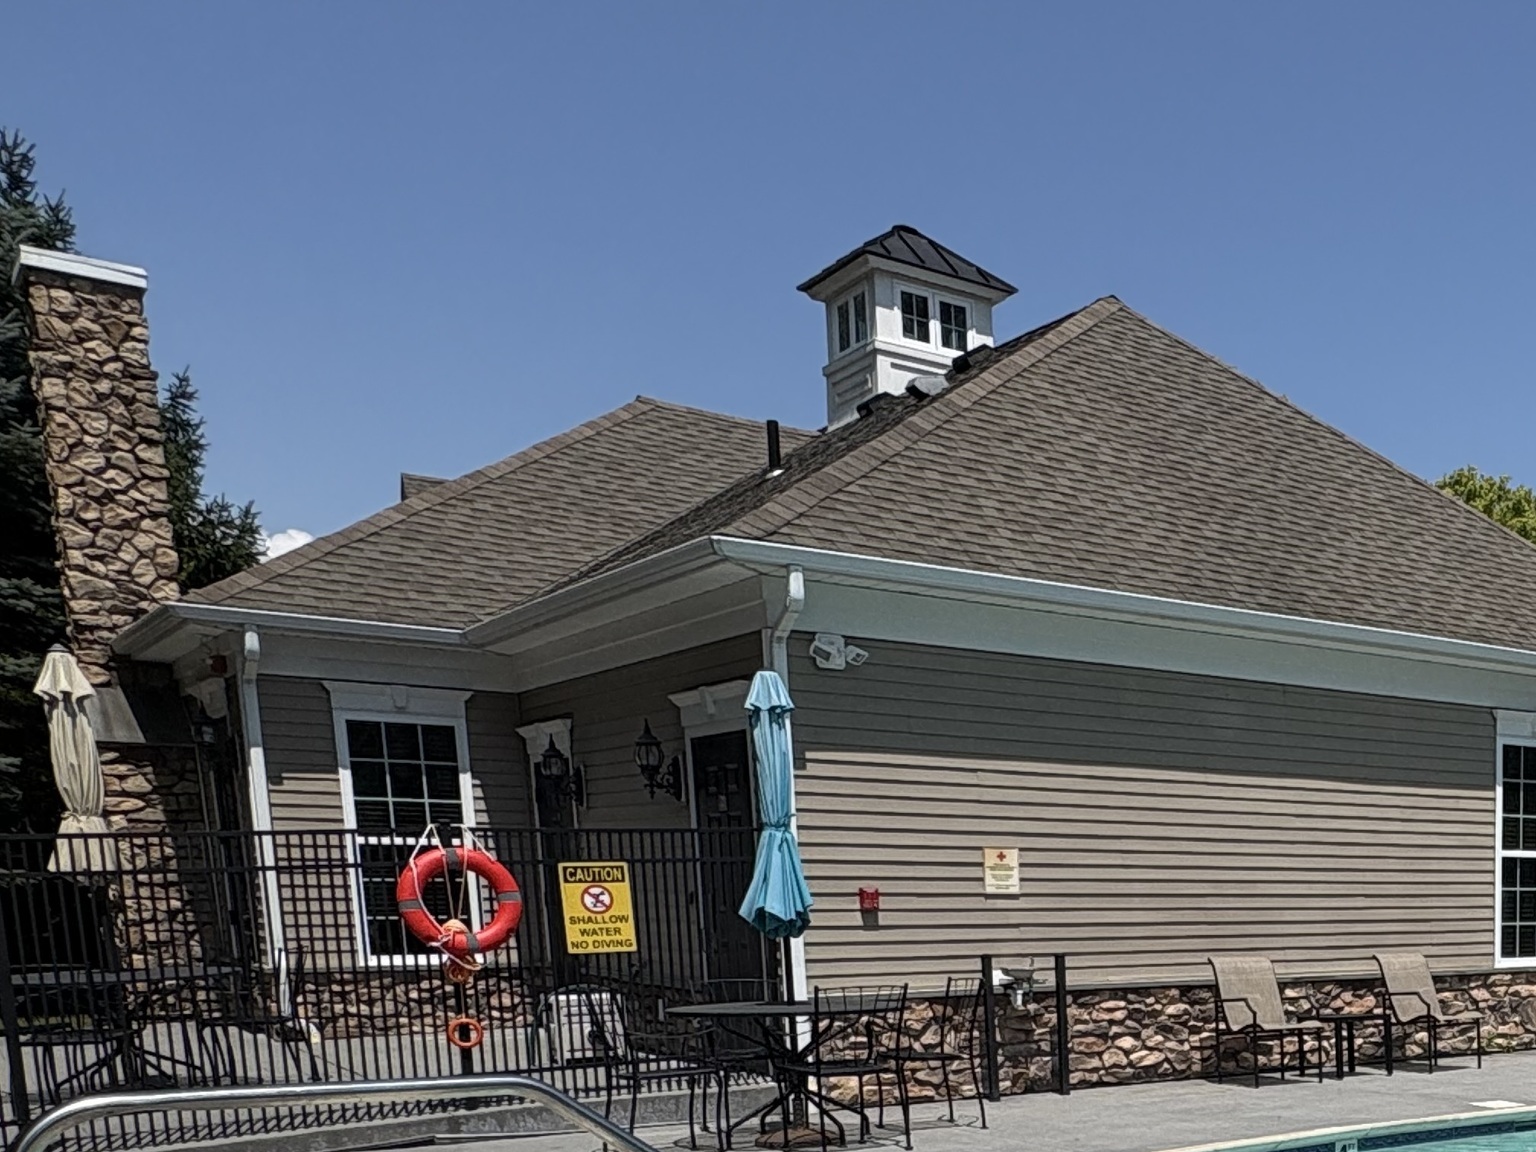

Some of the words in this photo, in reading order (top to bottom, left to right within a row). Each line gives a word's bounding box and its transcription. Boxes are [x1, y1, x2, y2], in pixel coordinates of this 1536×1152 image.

[565, 867, 622, 882] CAUTION
[568, 914, 630, 925] SHALLOW
[579, 927, 622, 937] WATER
[570, 941, 590, 950] NO
[592, 939, 634, 949] DIVING
